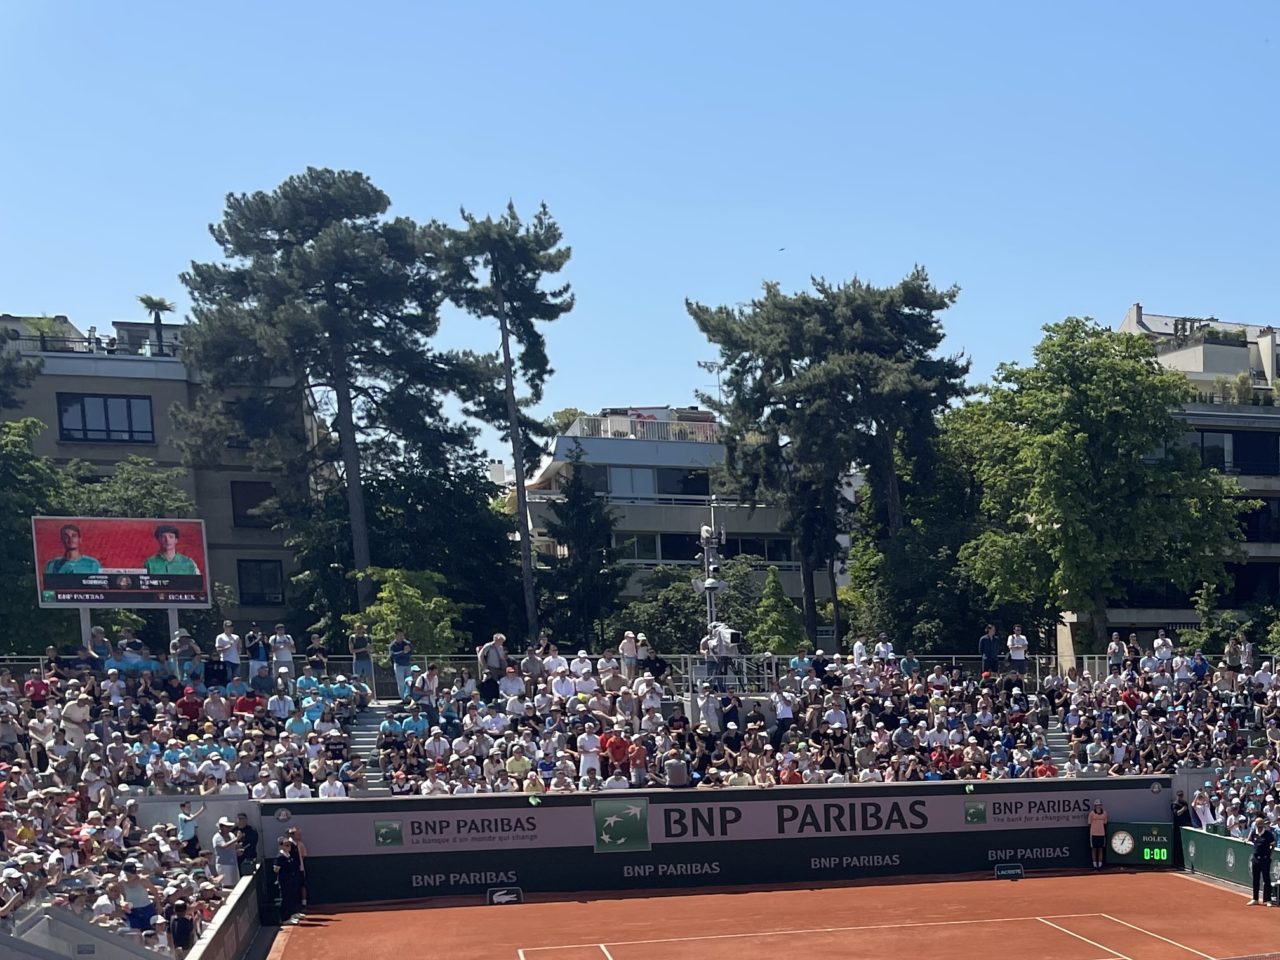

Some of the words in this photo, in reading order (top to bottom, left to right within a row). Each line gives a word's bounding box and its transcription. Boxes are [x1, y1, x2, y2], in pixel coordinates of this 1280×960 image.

[992, 801, 1024, 816] BNP
[1028, 798, 1091, 814] PARIBAS
[410, 820, 450, 836] BNP
[456, 816, 537, 835] PARIBAS
[663, 806, 742, 838] BNP
[776, 799, 929, 834] PARIBAS
[810, 857, 839, 870] BNP
[842, 854, 901, 868] PARIBAS
[988, 849, 1014, 861] BNP
[1017, 847, 1070, 860] PARIBAS
[1143, 848, 1167, 860] 0:00
[623, 864, 654, 878] BNP
[657, 862, 720, 876] PARIBAS
[412, 874, 446, 887] BNP
[450, 871, 517, 886] PARIBAS
